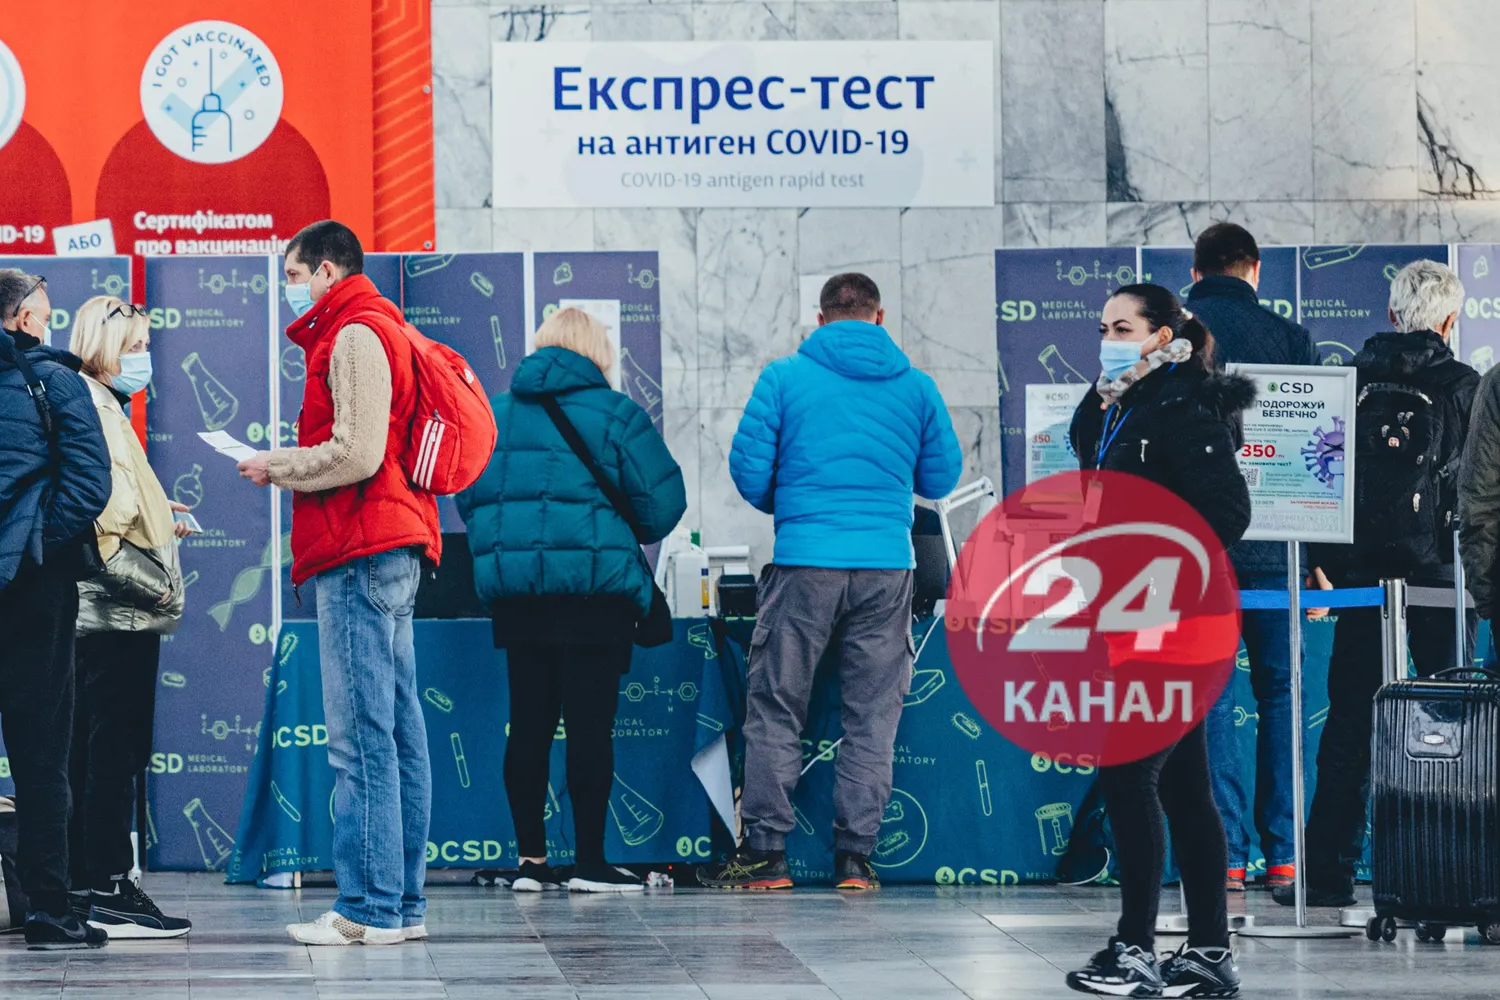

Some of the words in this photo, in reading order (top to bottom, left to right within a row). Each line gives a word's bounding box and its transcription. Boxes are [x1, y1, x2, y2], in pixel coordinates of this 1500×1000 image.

[182, 31, 270, 86] VACCINATED
[554, 66, 935, 124] Експрес-тест
[578, 136, 615, 154] на
[626, 134, 755, 154] антиген
[767, 129, 909, 154] COVID-19
[621, 173, 702, 188] COVID-19
[707, 173, 774, 191] antigen
[779, 172, 825, 191] rapid
[831, 173, 864, 187] test
[134, 210, 272, 234] Сертифікатом
[68, 233, 101, 251] АБО
[135, 240, 171, 254] про
[185, 309, 224, 317] MEDICAL
[1001, 301, 1036, 321] SD
[1042, 301, 1085, 309] MEDICAL
[150, 308, 181, 328] SD
[1301, 309, 1370, 318] LABORATORY
[1280, 382, 1313, 393] CSD
[1257, 400, 1324, 411] ПОДОРОЖУЙ
[1263, 410, 1317, 418] БЕЗПЕЧНО
[1033, 434, 1050, 443] 350
[1242, 444, 1275, 457] 350
[187, 539, 246, 547] LABORATORY
[278, 725, 328, 747] CSD
[151, 753, 183, 773] SD
[188, 765, 248, 773] LABORATORY
[441, 841, 501, 861] CSD
[958, 868, 1018, 884] CSD
